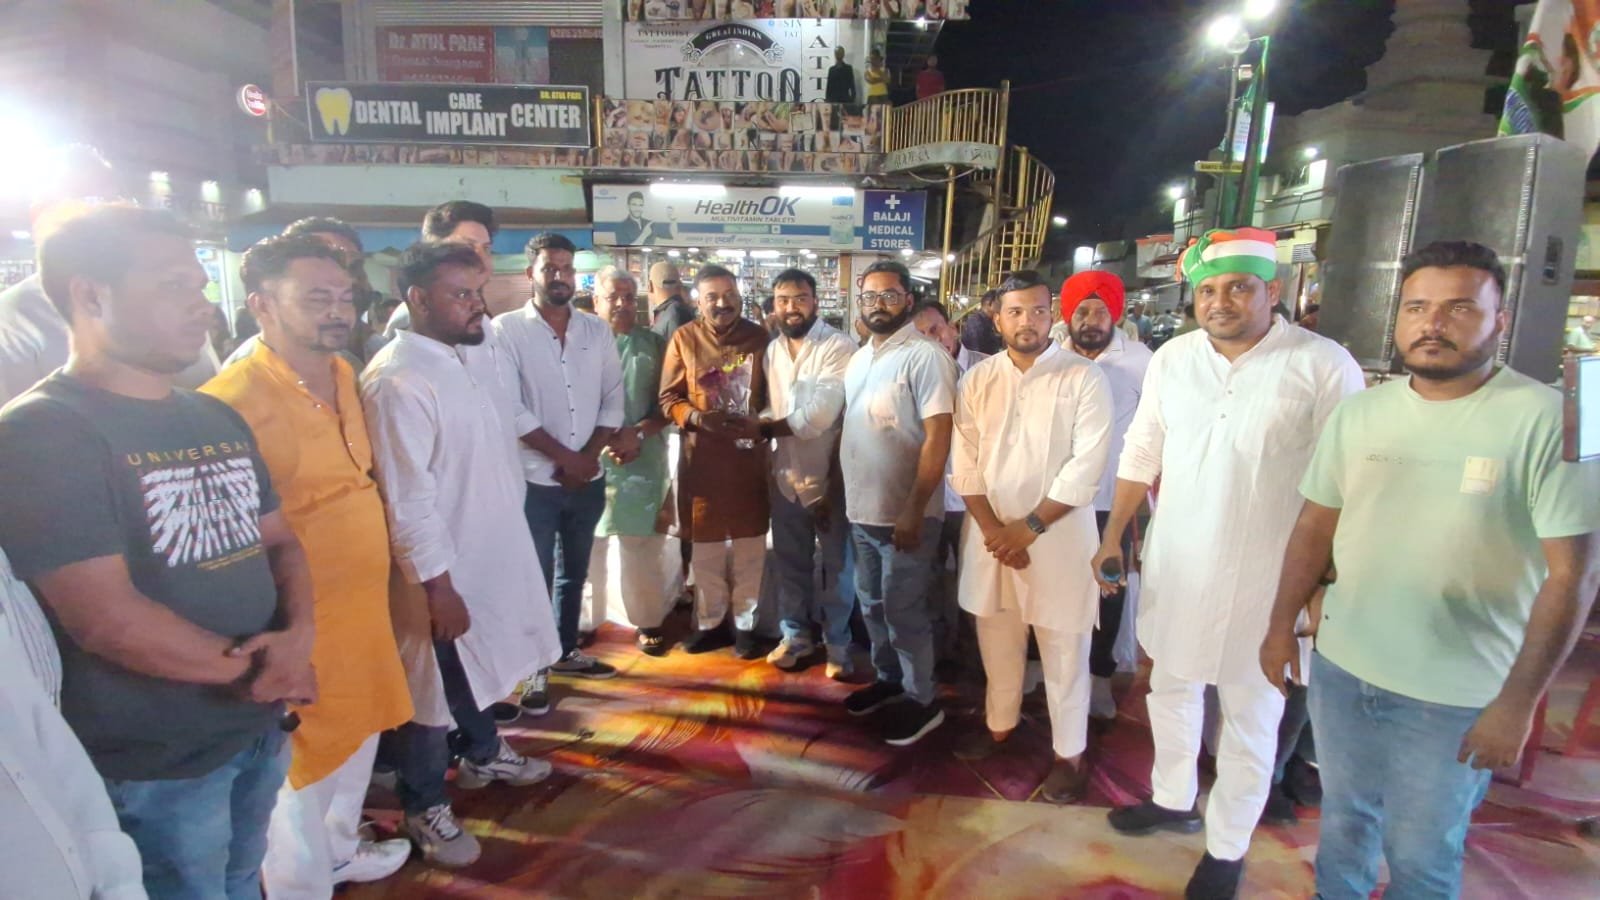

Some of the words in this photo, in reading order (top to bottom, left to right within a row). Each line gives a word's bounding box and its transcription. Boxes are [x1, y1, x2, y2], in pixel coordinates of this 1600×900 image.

[448, 92, 483, 110] CARE
[354, 100, 422, 125] DENTAL
[510, 103, 581, 129] CENTER
[425, 110, 508, 137] IMPLANT
[694, 195, 801, 217] HealthOK
[872, 211, 911, 222] BALAJI
[867, 225, 915, 236] MEDICAL
[870, 238, 911, 249] STORES
